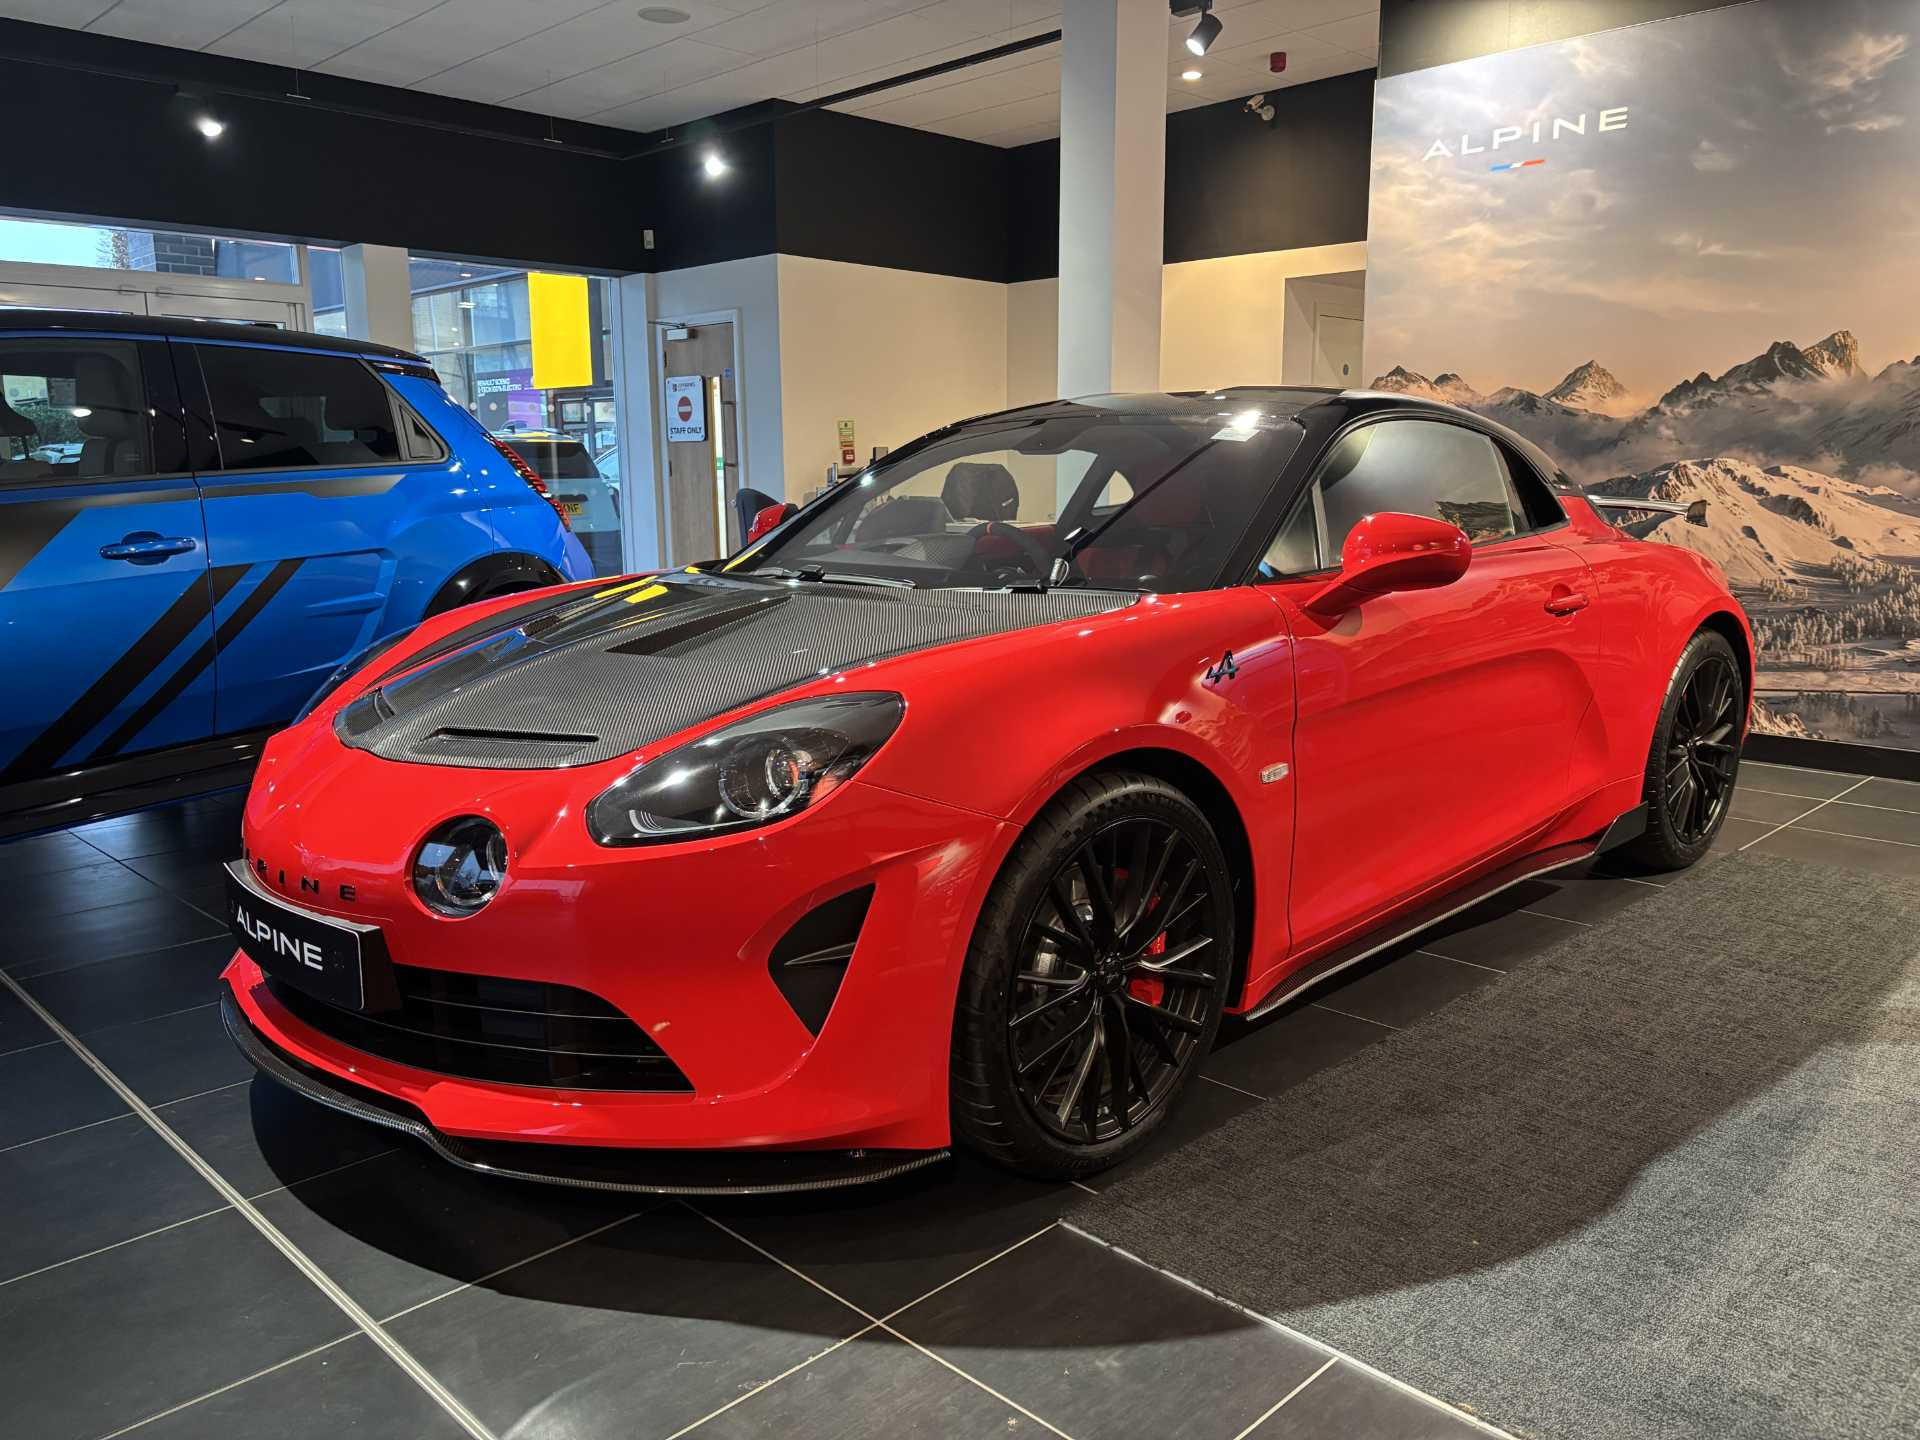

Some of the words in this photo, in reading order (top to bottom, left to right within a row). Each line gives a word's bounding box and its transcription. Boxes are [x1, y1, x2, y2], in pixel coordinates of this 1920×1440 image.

[1423, 106, 1629, 161] ALPINE
[670, 427, 686, 435] STAFF
[687, 426, 702, 434] ONLY
[248, 851, 356, 901] PINE
[237, 905, 323, 971] ALPINE
